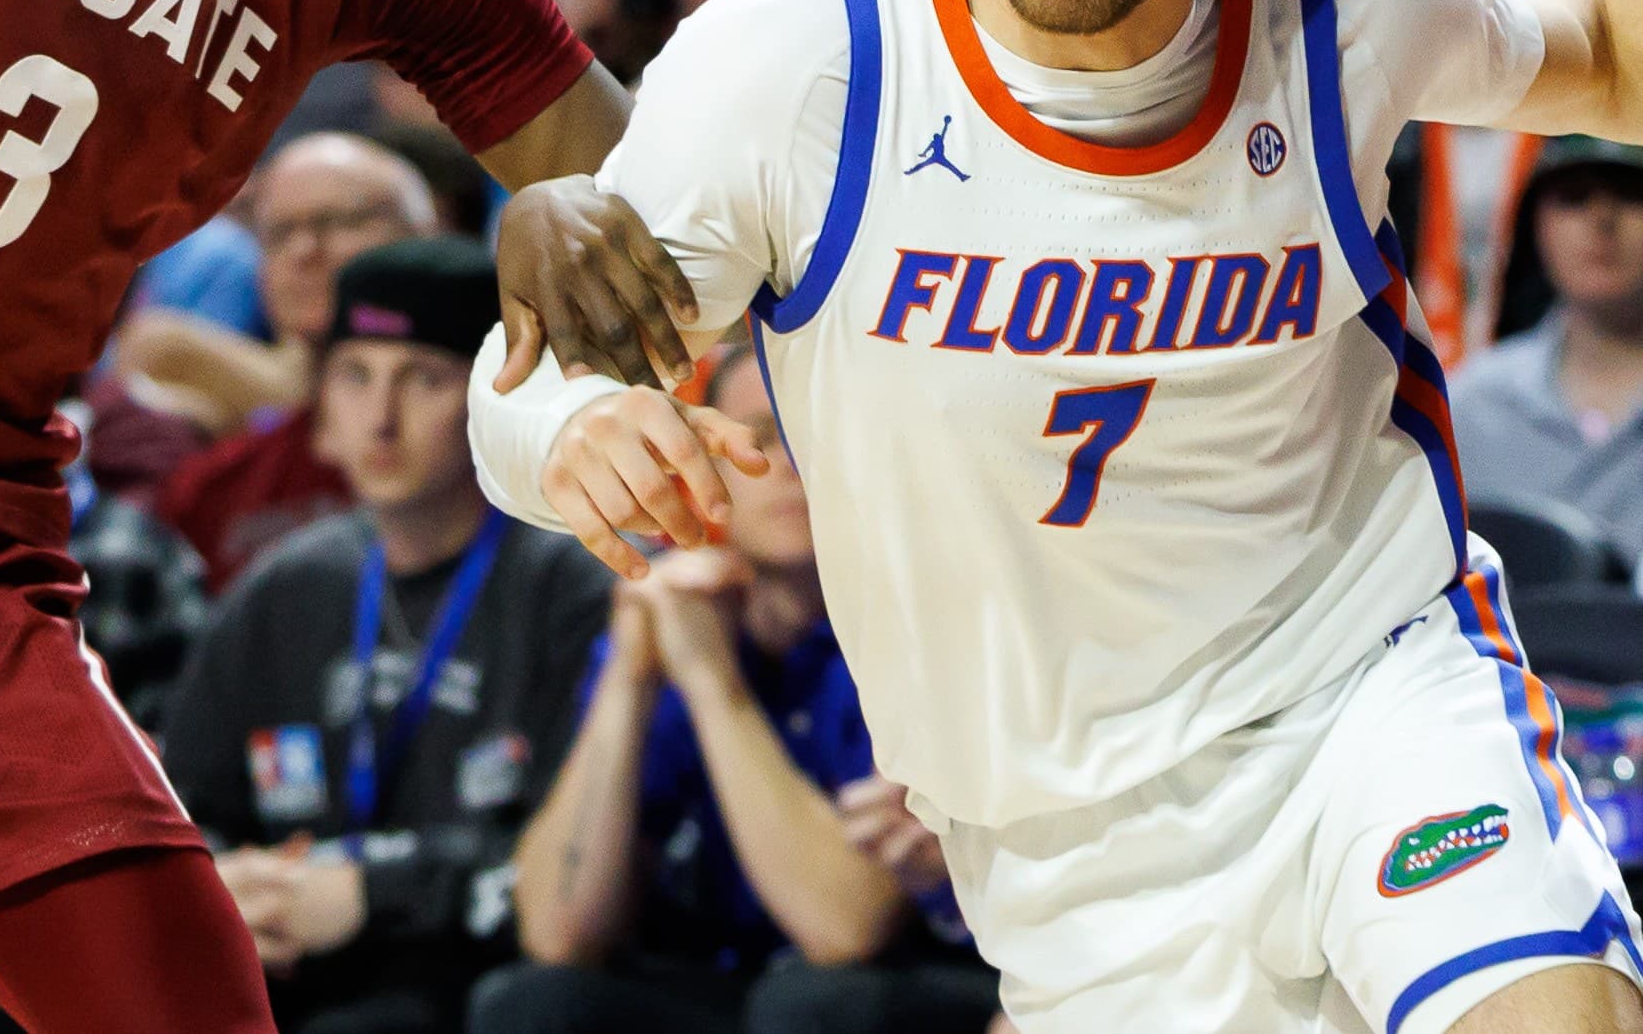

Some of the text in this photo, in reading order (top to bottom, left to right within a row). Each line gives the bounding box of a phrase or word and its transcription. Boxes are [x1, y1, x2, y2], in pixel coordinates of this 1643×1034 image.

[1249, 126, 1283, 173] SEC
[866, 242, 1323, 355] FLORIDA
[1037, 377, 1157, 528] 7
